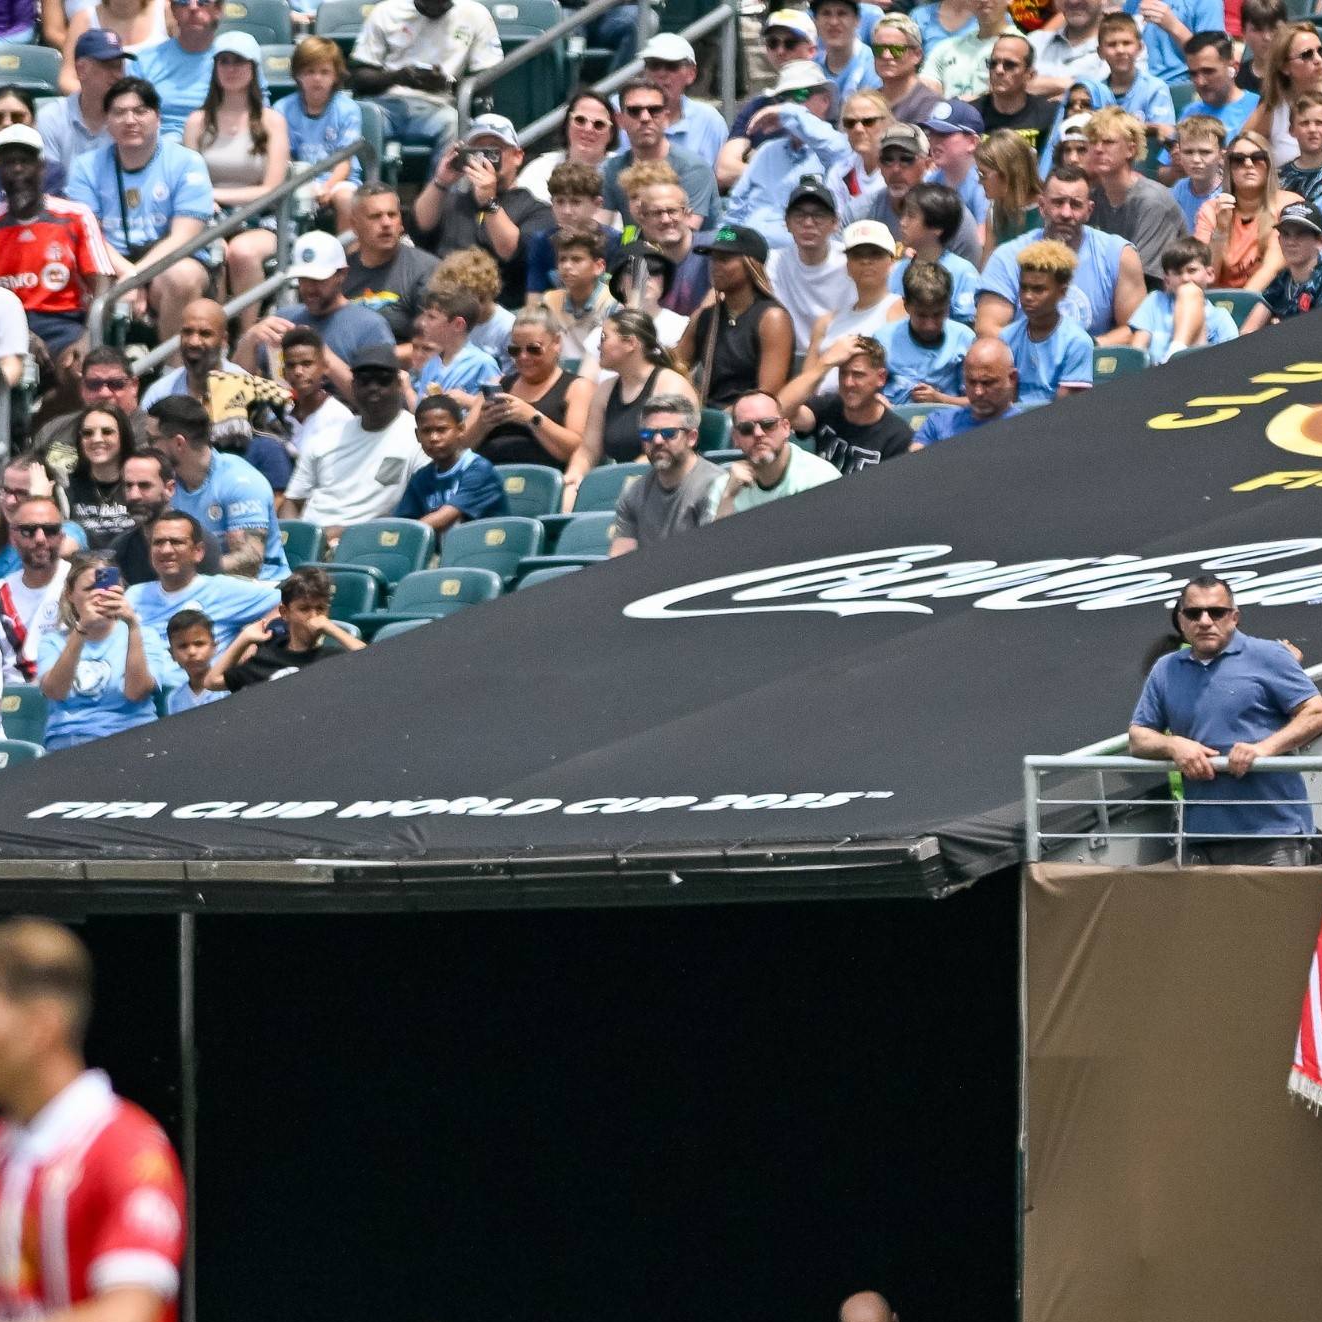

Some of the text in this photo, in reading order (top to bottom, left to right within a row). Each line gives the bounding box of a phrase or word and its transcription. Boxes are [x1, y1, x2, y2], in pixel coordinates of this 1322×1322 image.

[27, 801, 167, 819] FIFA
[171, 800, 339, 820] CLUB
[336, 796, 564, 819] WORLD
[562, 794, 700, 816] CUP
